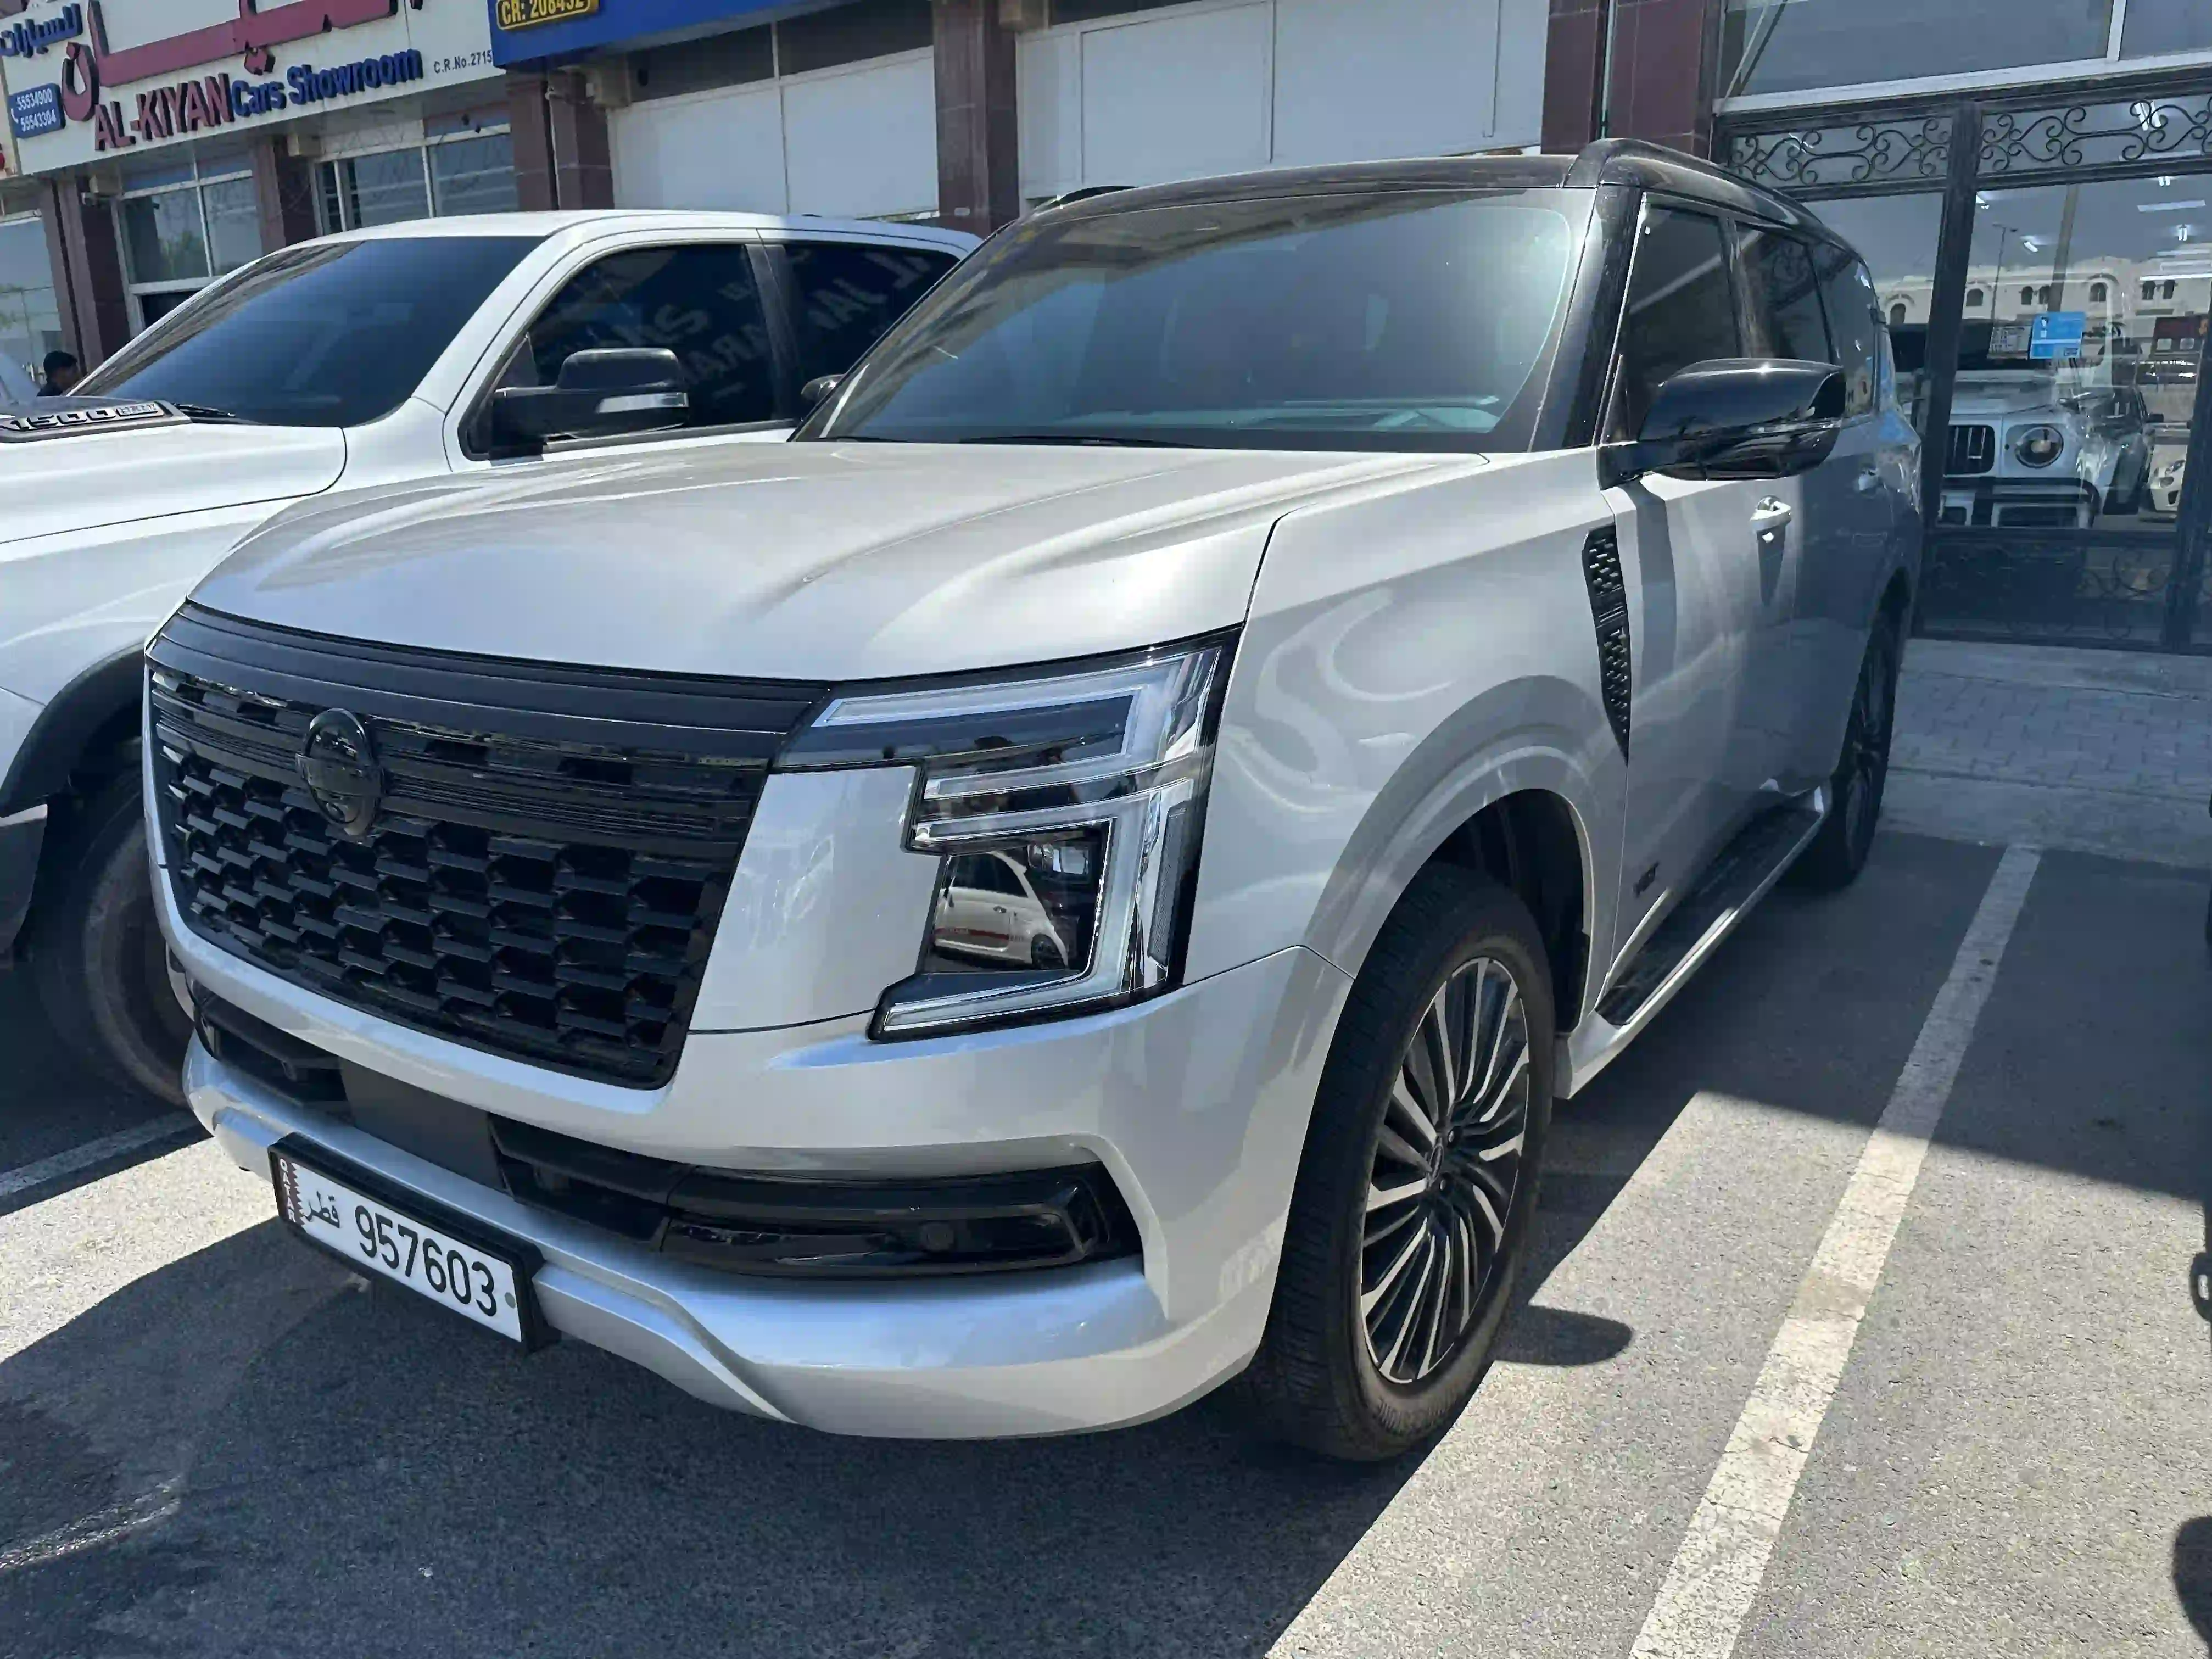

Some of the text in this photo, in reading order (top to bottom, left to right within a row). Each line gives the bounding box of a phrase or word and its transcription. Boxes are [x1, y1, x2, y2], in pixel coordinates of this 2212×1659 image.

[94, 48, 423, 151] AL-KIYAN Cars Showroom
[10, 409, 116, 431] 1500
[280, 1158, 296, 1223] QATAR
[303, 1189, 340, 1229] قطر
[355, 1205, 497, 1317] 957603
